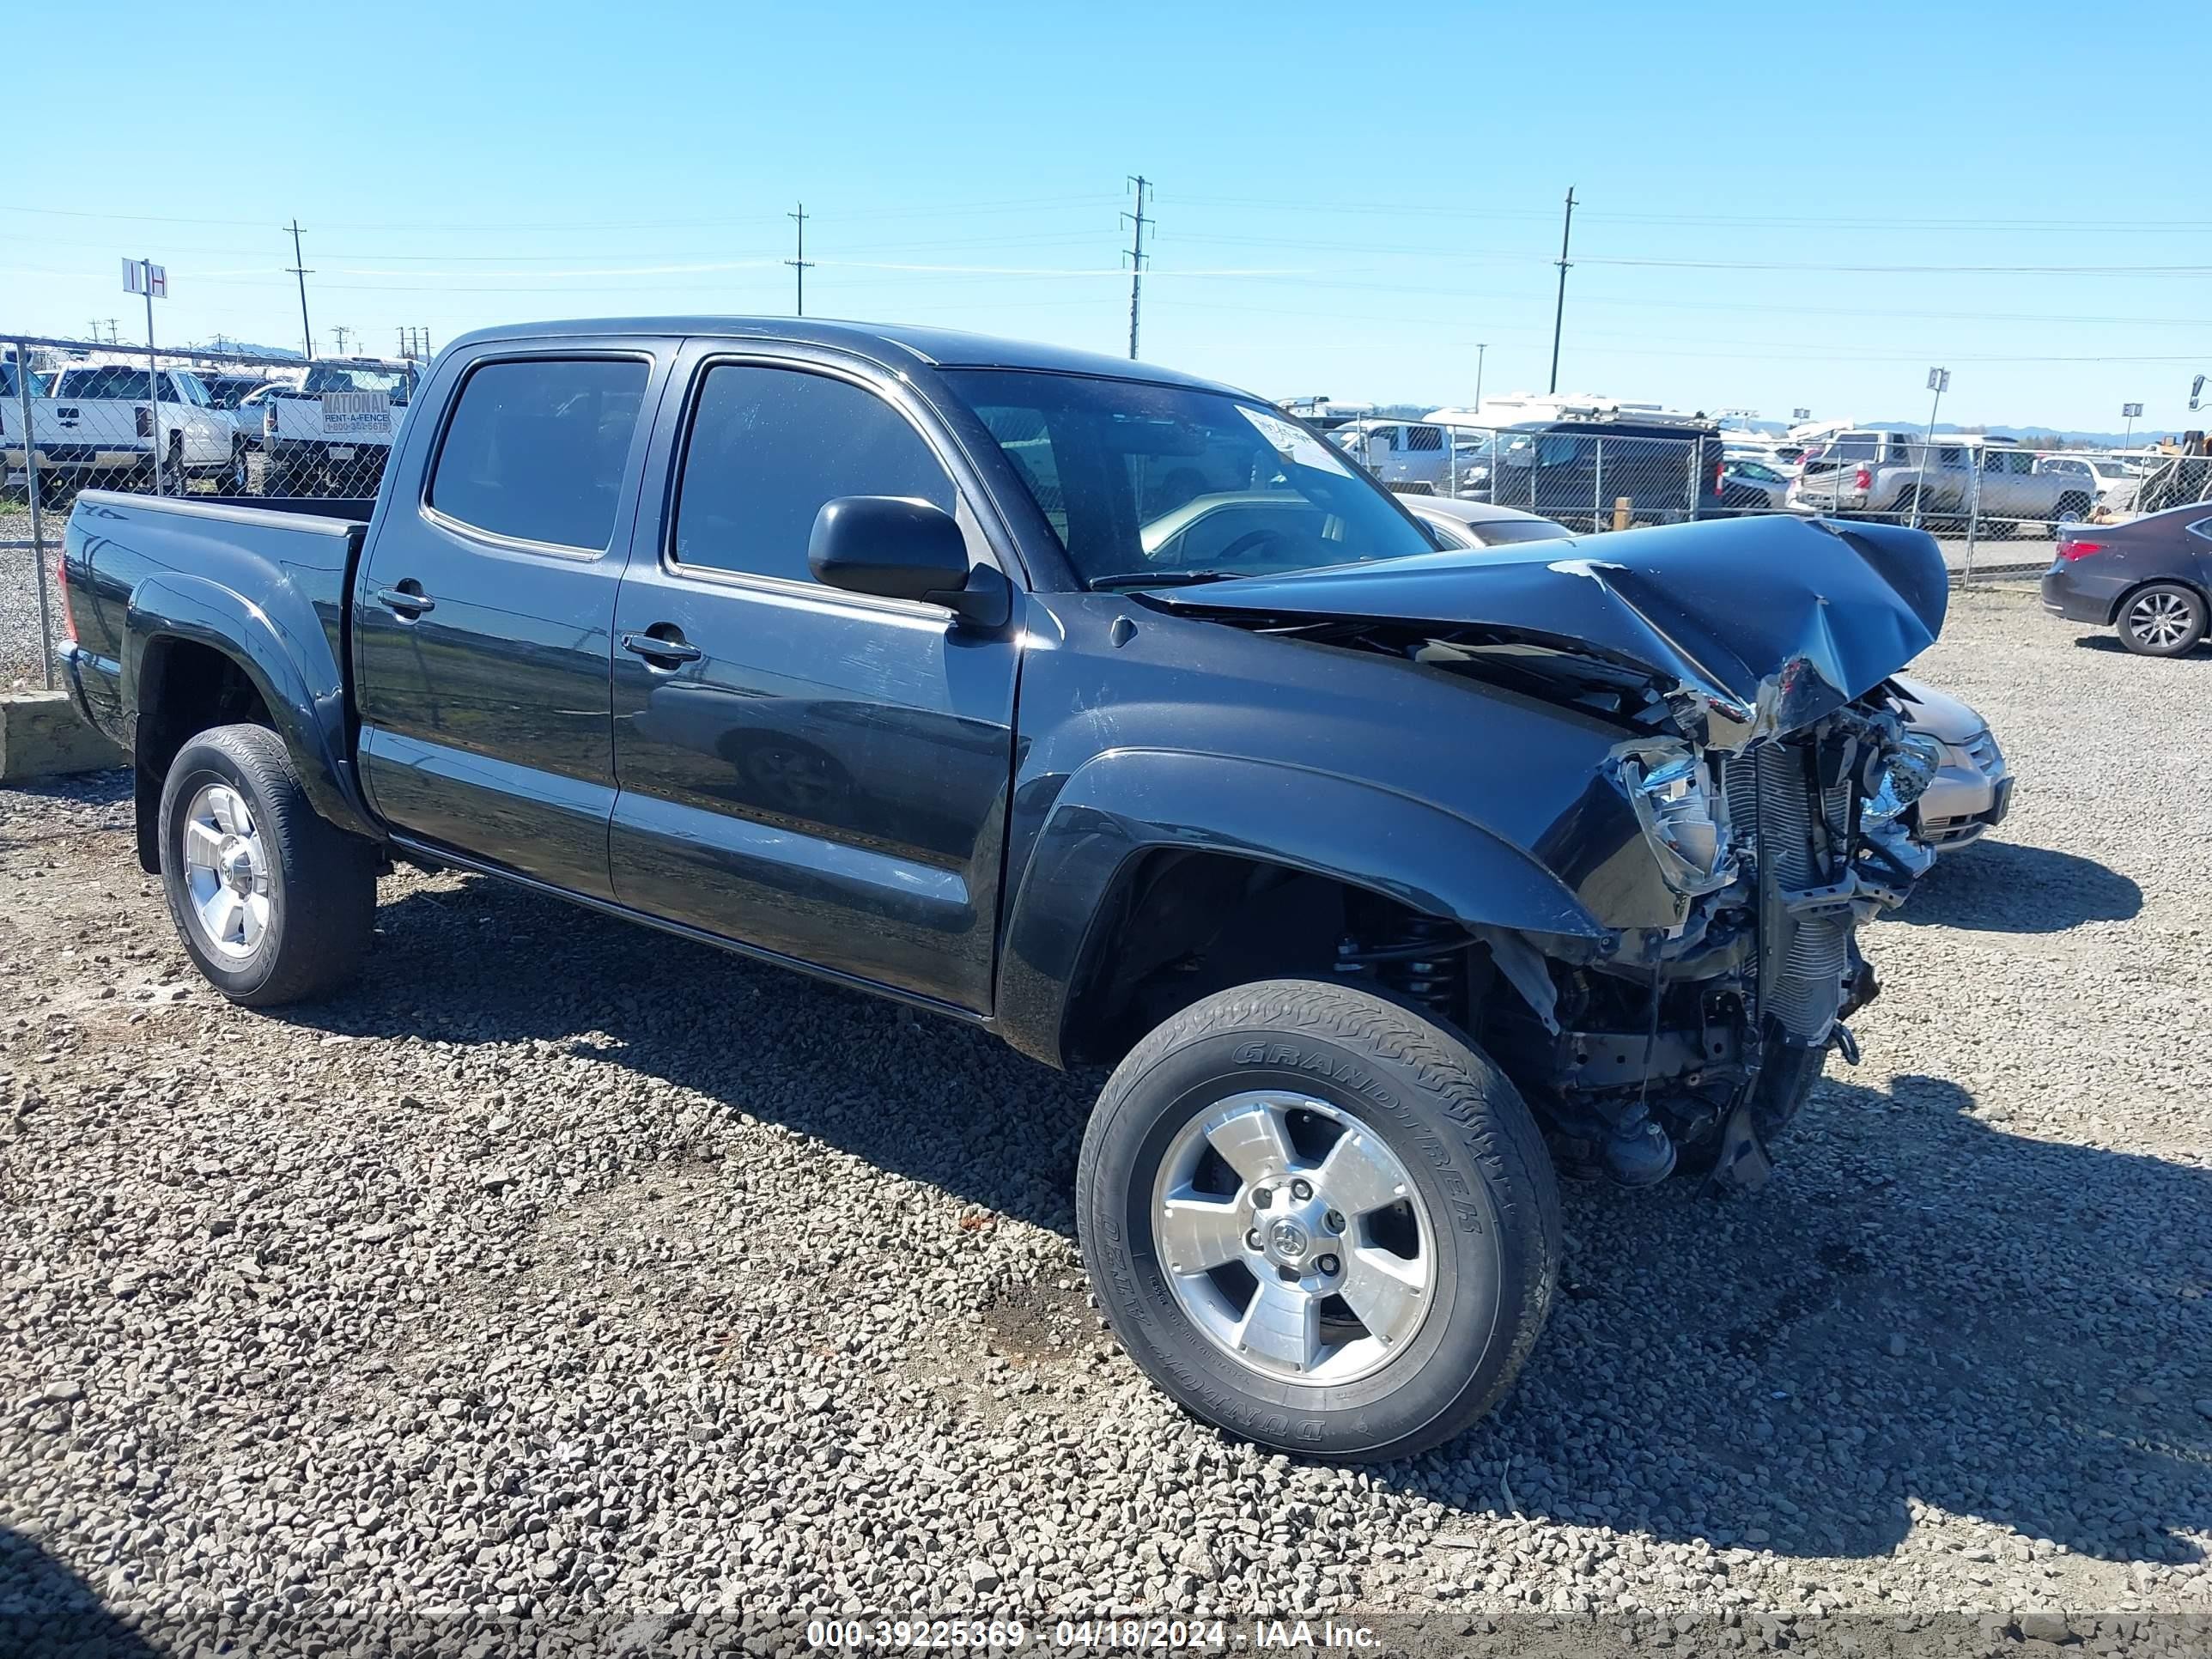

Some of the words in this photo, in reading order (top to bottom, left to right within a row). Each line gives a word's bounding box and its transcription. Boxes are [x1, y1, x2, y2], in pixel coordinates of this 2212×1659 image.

[150, 266, 165, 296] H
[323, 393, 388, 412] NATIONAL
[1232, 1041, 1482, 1235] GRANDTREK
[1149, 1344, 1327, 1443] DUNLOP
